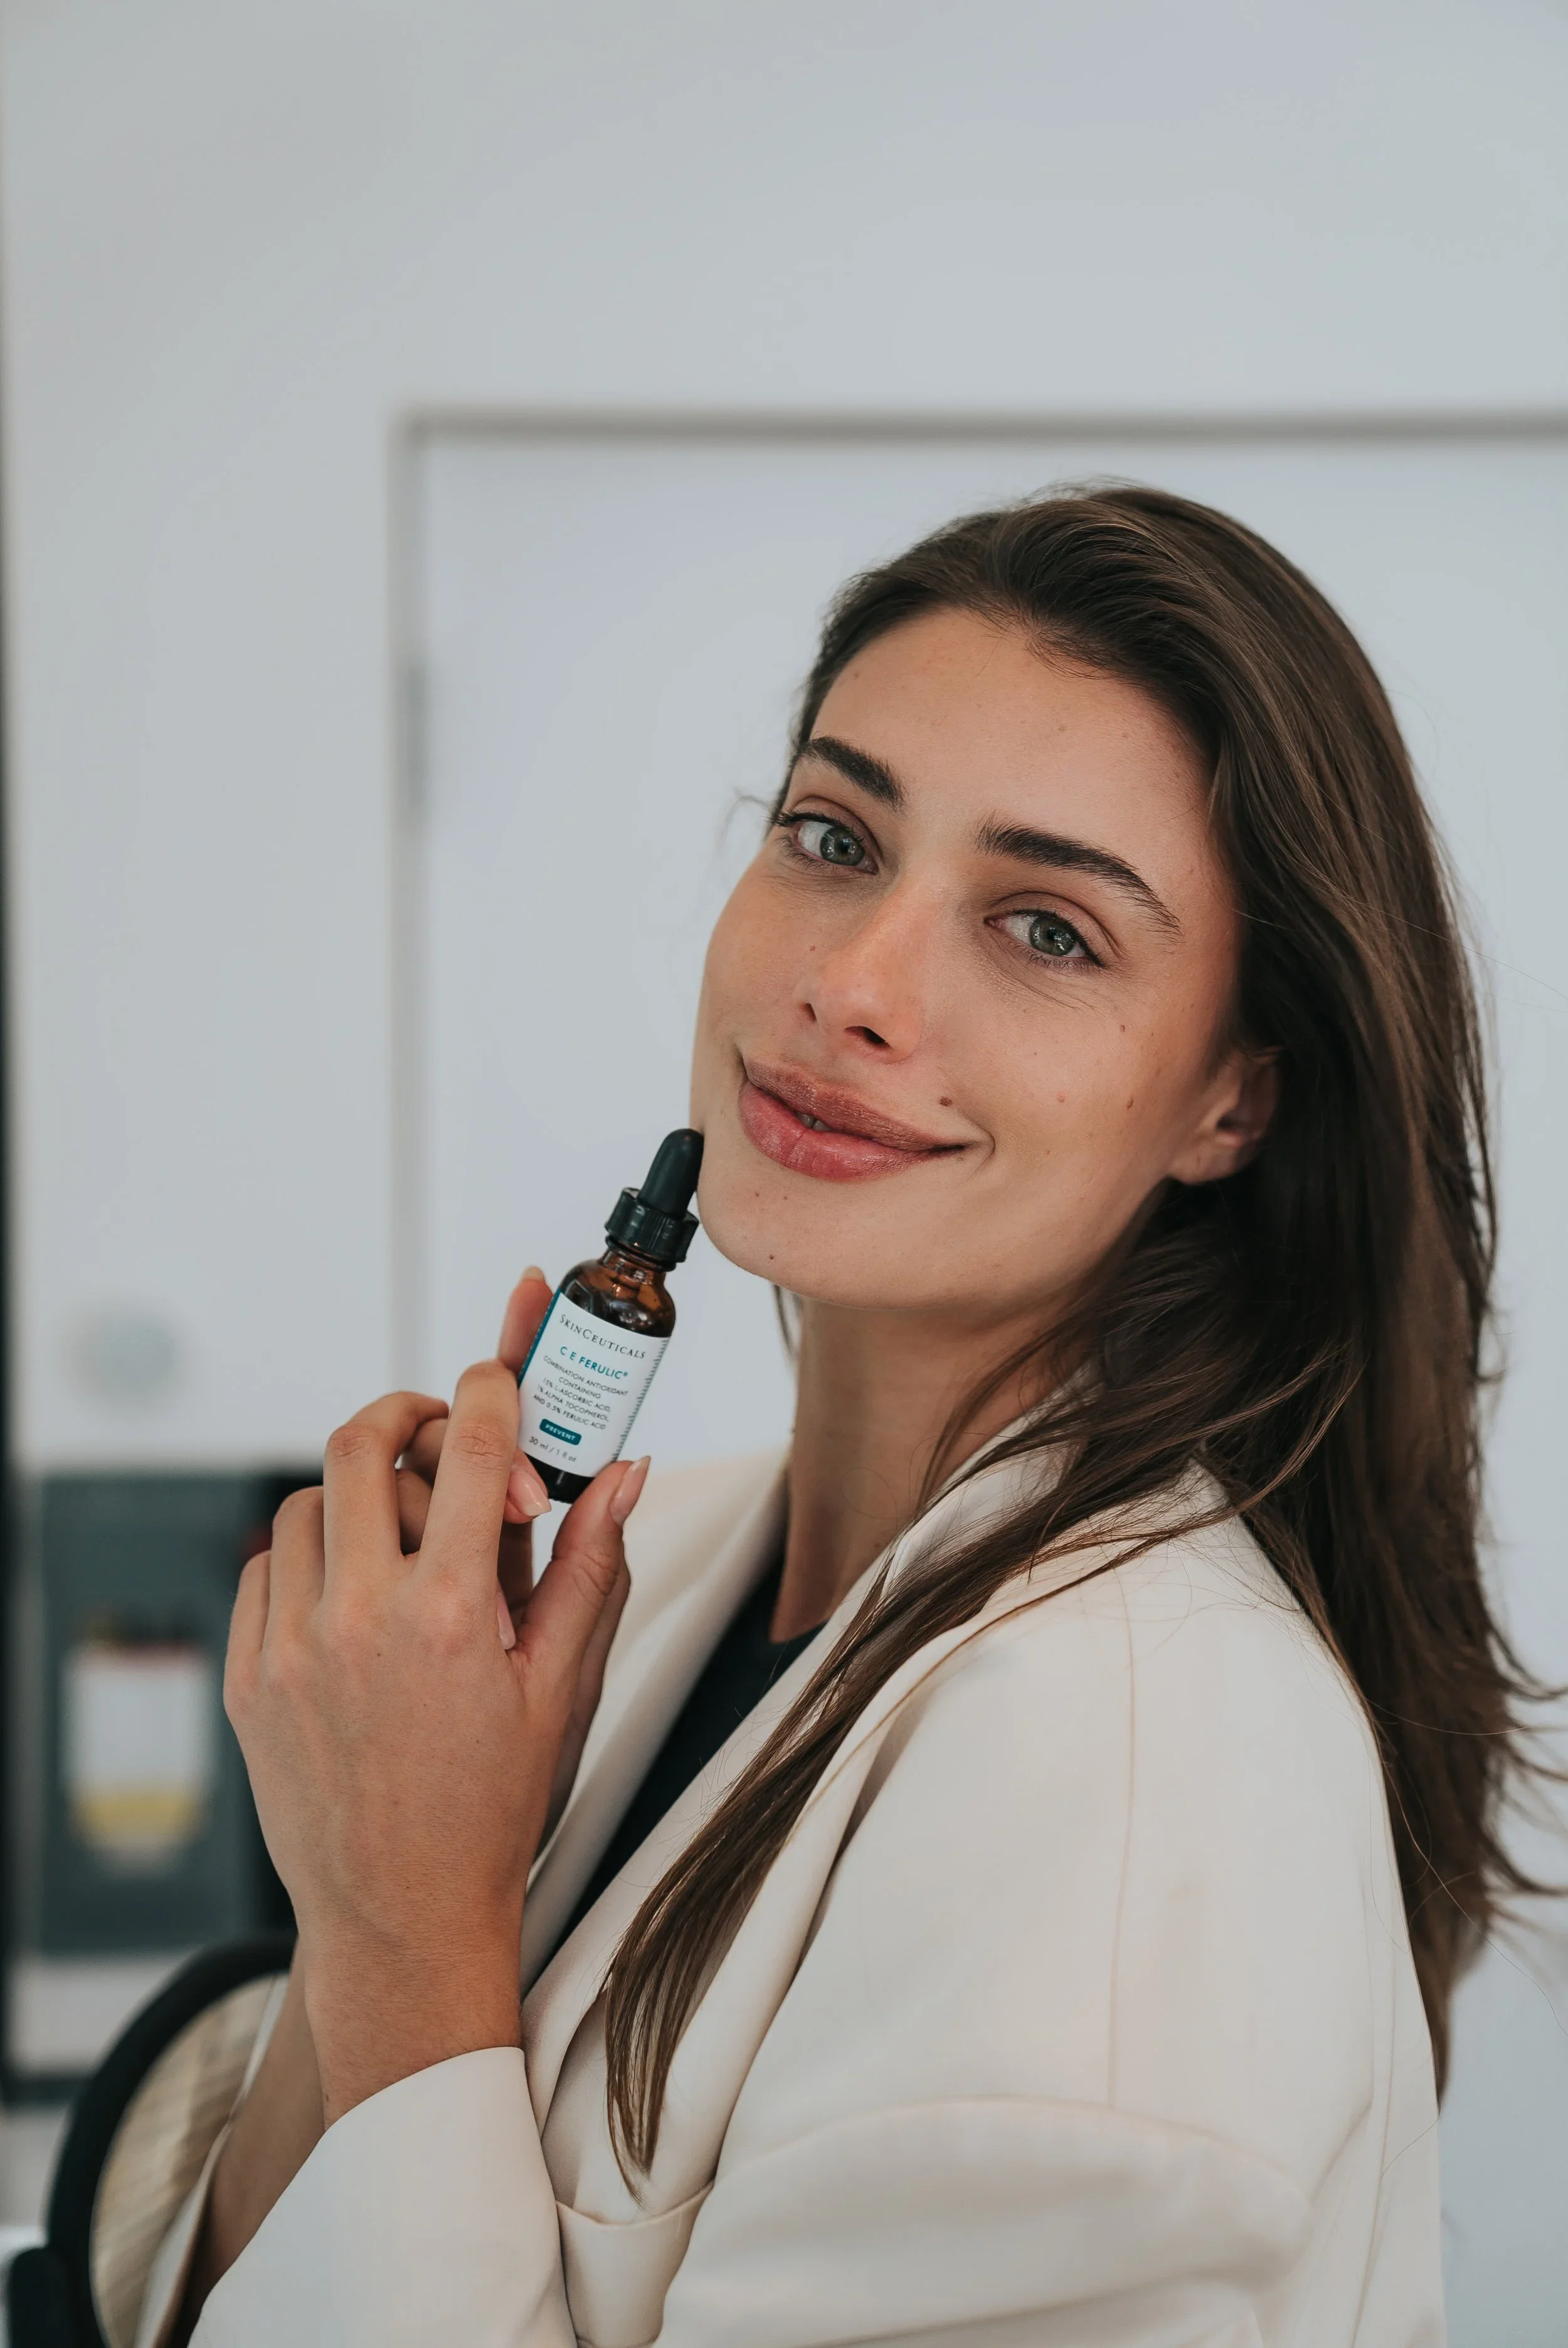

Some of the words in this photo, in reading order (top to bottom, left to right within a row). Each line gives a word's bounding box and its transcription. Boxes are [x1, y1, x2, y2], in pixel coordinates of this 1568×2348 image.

[560, 1346, 568, 1356] C
[569, 1352, 576, 1361] E
[543, 1355, 585, 1382] COMBINATION
[585, 1380, 628, 1396] ANTIOXIDANT
[559, 1377, 601, 1399] CONTAINING
[544, 1391, 563, 1403] ALPHA
[532, 1394, 545, 1405] AND
[563, 1411, 589, 1425] FERULIC
[590, 1421, 606, 1430] ACID
[545, 1424, 576, 1440] PREVENT
[529, 1436, 538, 1445] 30
